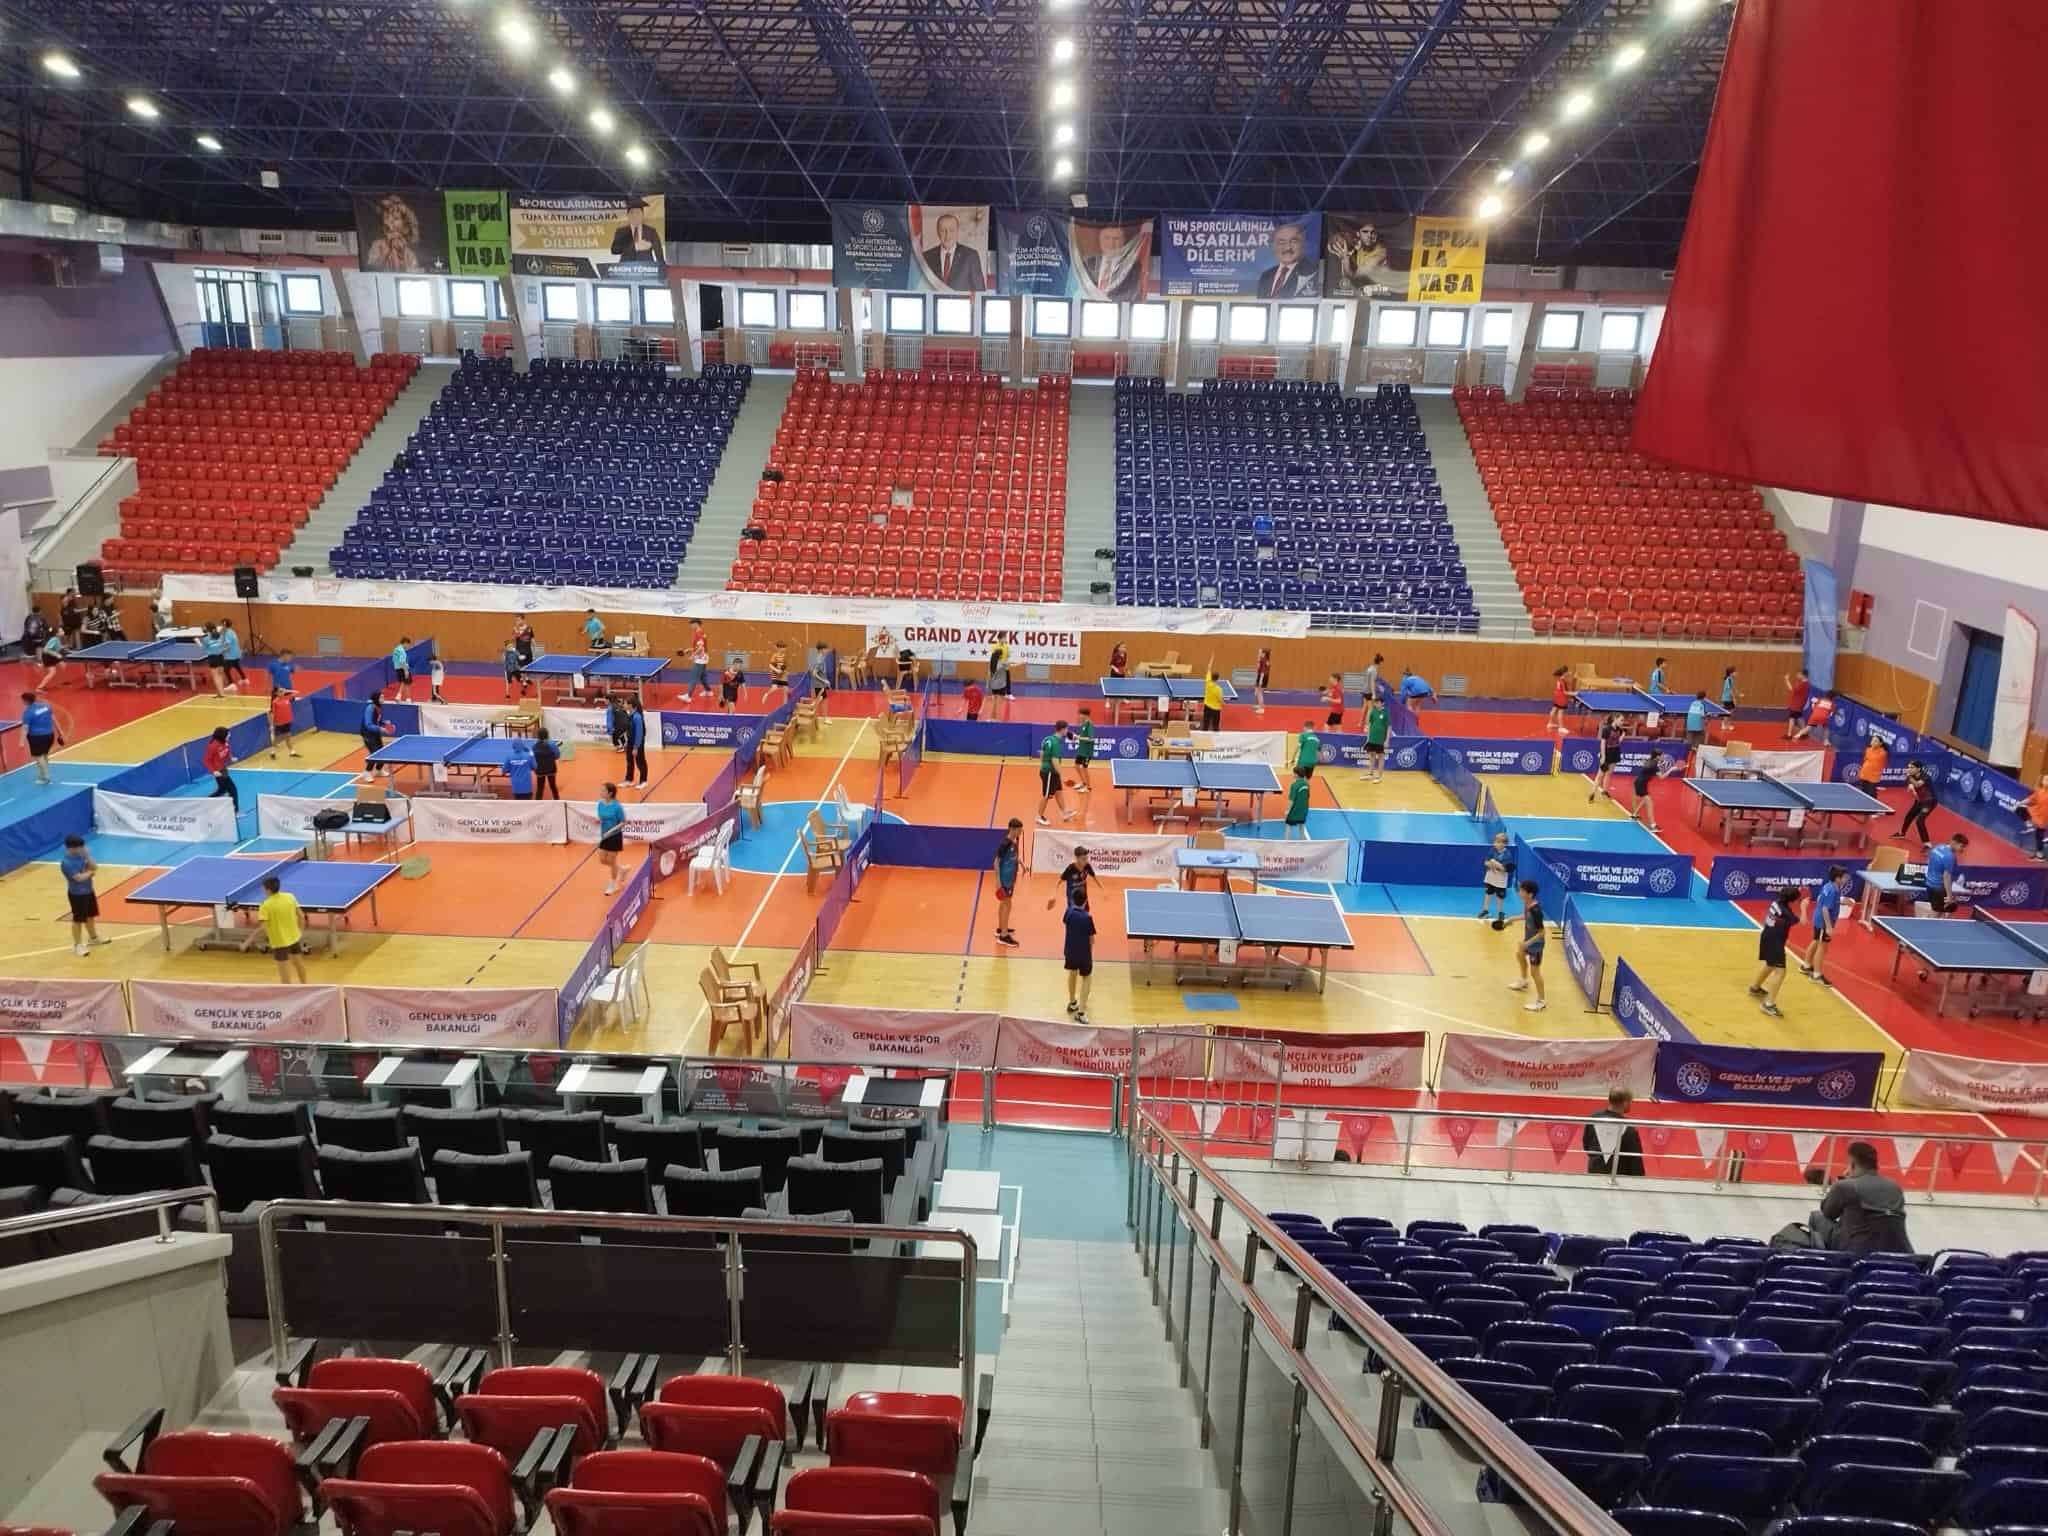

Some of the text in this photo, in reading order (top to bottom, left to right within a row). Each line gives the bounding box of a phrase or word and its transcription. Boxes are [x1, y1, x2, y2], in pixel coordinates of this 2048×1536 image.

[520, 199, 611, 209] SPORCULARIMIZA
[456, 224, 478, 241] LA
[1168, 220, 1276, 233] TÜM SPORCULARIMIZA
[1173, 233, 1270, 247] BAŞARILAR
[1187, 248, 1256, 262] DİLERİM
[1420, 250, 1447, 267] LA
[1418, 273, 1474, 293] YAŞA
[904, 627, 1078, 648] GRAND AYZK HOTEL
[1576, 864, 1646, 876] GENÇLİK VE SPOR
[1581, 872, 1588, 881] İL
[1790, 877, 1800, 885] VE
[1801, 878, 1824, 886] SPOR
[26, 999, 39, 1009] VE
[41, 999, 68, 1009] SPOR
[194, 1007, 282, 1020] GENÇLİK VE SPOR
[408, 1011, 497, 1022] GENÇLİK VE SPOR
[211, 1020, 266, 1031] BAKANLIĞI
[426, 1022, 481, 1033] BAKANLIĞI
[852, 1031, 940, 1045] GENÇLİK VE SPOR
[868, 1042, 924, 1054] BAKANLIĞI
[1055, 1046, 1146, 1058] GENÇLİK VE SPR
[1272, 1051, 1364, 1062] GNÇLİK VE SPOR
[1290, 1062, 1357, 1074] MÜDÜRLÜĞÜ
[1719, 1072, 1813, 1085] GENÇLİK VE SPOR
[1529, 1080, 1559, 1090] ORDU
[1967, 1081, 2016, 1096] GENÇLİK
